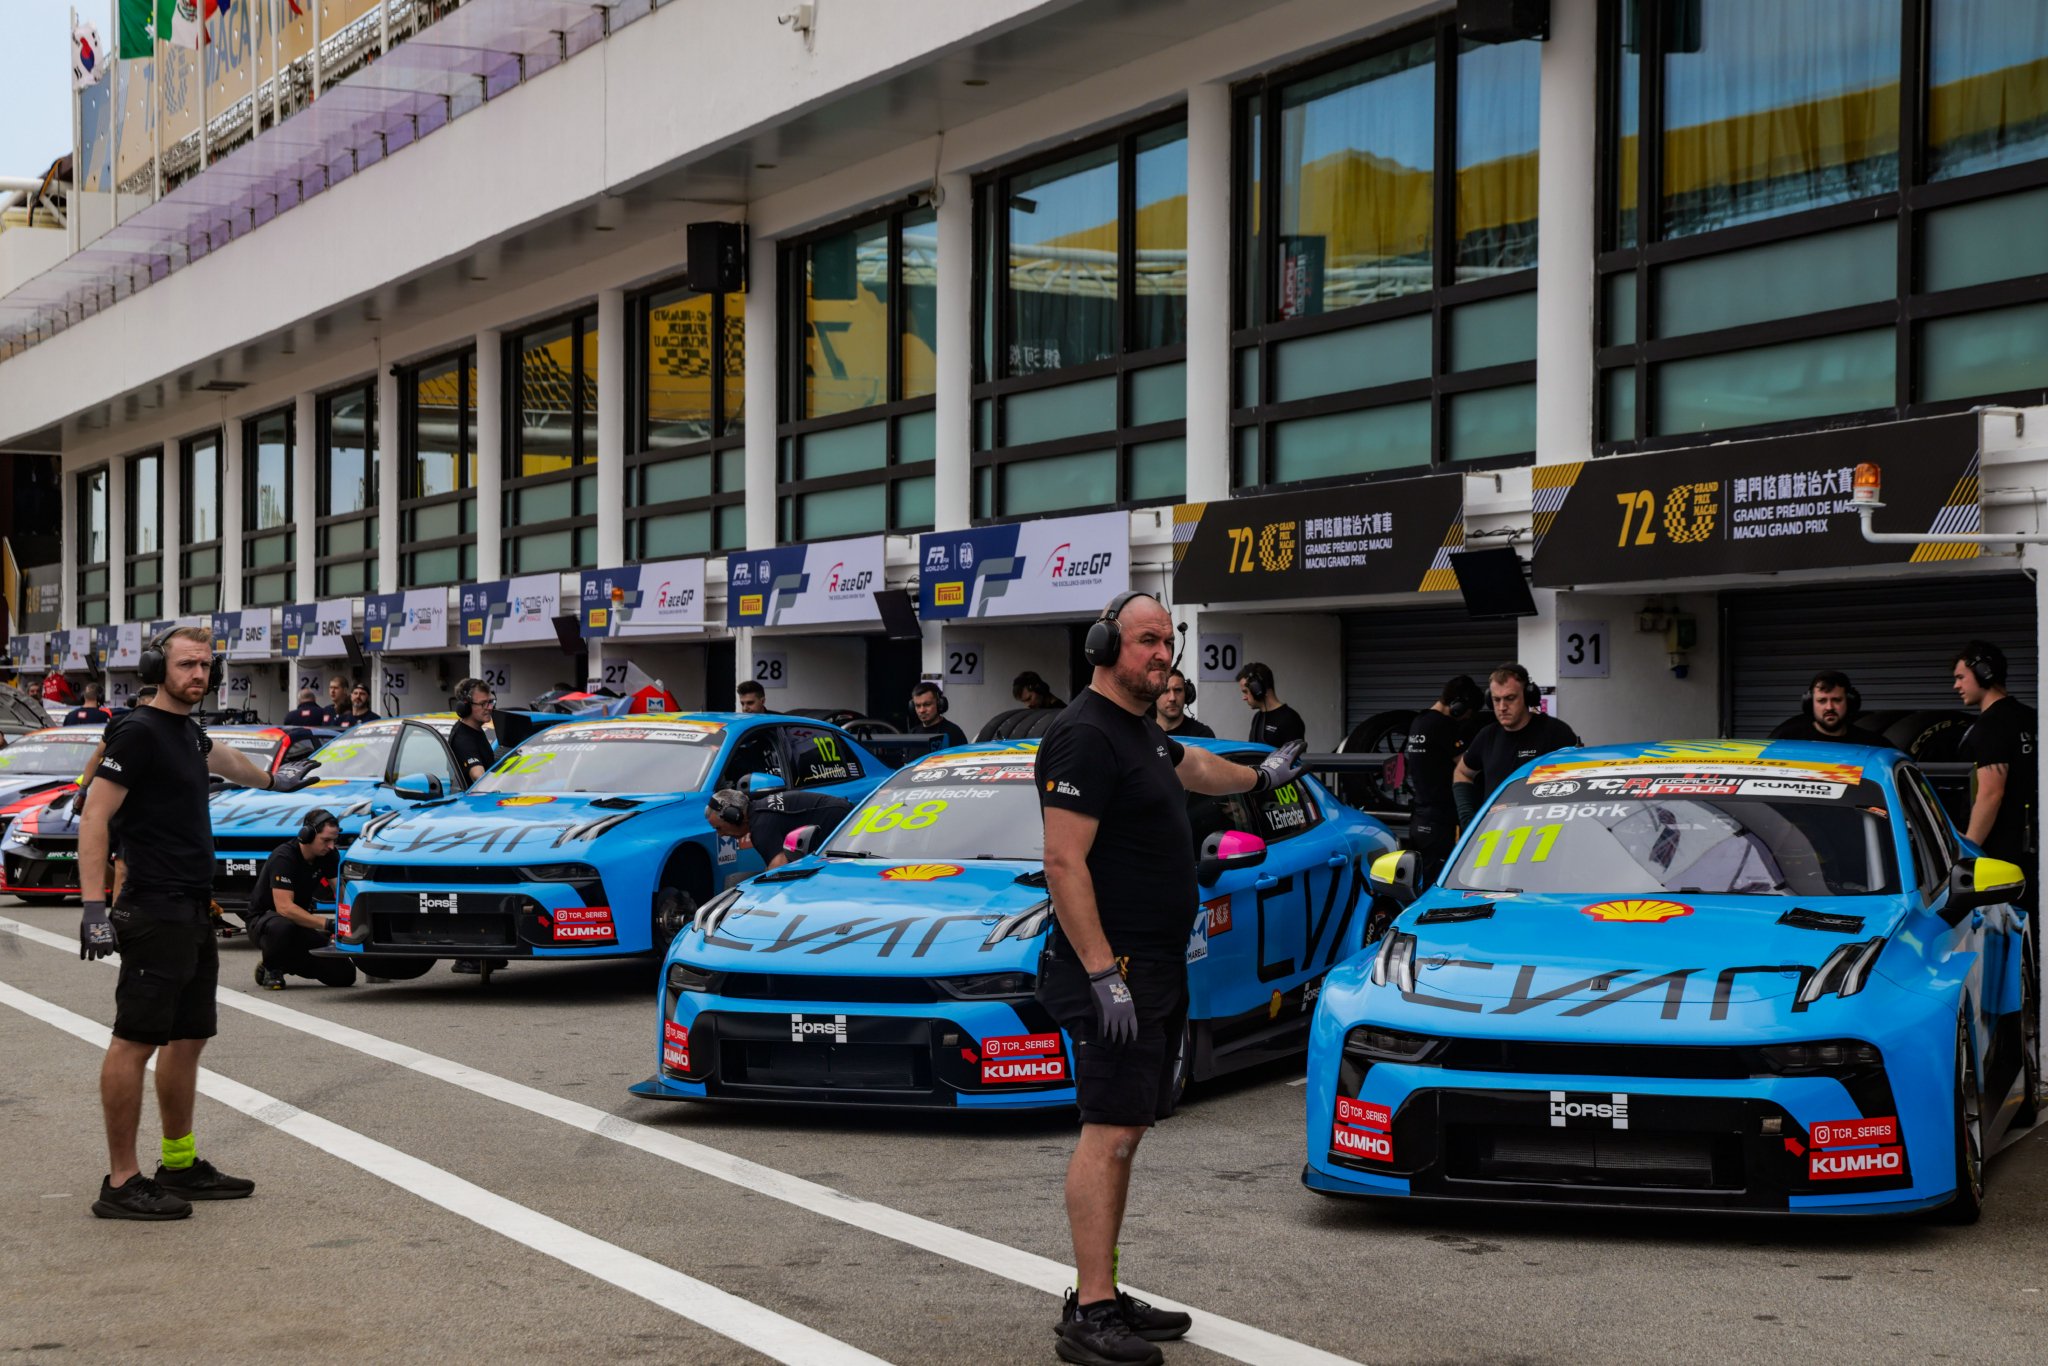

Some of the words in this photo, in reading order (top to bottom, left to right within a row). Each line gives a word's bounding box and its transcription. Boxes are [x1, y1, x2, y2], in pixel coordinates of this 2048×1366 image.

[1694, 481, 1719, 493] GRAND
[1694, 494, 1711, 504] PRIX
[1616, 489, 1656, 548] 72
[1694, 504, 1718, 517] MACAU
[1733, 504, 1775, 523] GRANDE
[1776, 501, 1814, 520] PRÉMIO
[1816, 502, 1831, 516] DE
[1733, 523, 1767, 540] MACAU
[1768, 520, 1803, 536] GRAND
[1804, 519, 1828, 534] PRIX
[1227, 526, 1255, 574] 72
[1305, 543, 1332, 555] GRANDE
[1332, 540, 1358, 554] PRÉMIO
[1358, 541, 1368, 551] DE
[1369, 538, 1393, 550] MACAU
[1305, 557, 1327, 569] MACAU
[1327, 555, 1350, 567] GRAND
[1350, 554, 1367, 566] PRIX
[937, 586, 961, 602] PIRELLI
[1567, 632, 1601, 666] 31
[949, 651, 978, 675] 29
[1204, 644, 1237, 671] 30
[485, 670, 506, 686] 26
[605, 665, 629, 684] 27
[756, 660, 782, 680] 28
[114, 683, 129, 695] 21
[231, 678, 249, 691] 23
[301, 677, 319, 690] 24
[387, 673, 404, 689] 25
[813, 736, 841, 762] 112
[1057, 785, 1081, 797] HELIX
[1539, 783, 1573, 796] FIA
[1587, 777, 1653, 790] TCR
[1665, 785, 1730, 794] TOUR
[1752, 782, 1832, 791] KUMHO
[848, 799, 948, 837] 168
[1523, 803, 1629, 822] T.Björk
[1473, 824, 1563, 869] 111
[226, 861, 257, 874] HORSE
[420, 895, 458, 911] HORSE
[568, 911, 608, 920] TCR_SERIES
[556, 926, 612, 937] KUMHO
[791, 1017, 847, 1039] HORSE
[1001, 1040, 1055, 1051] TCR_SERIES
[984, 1061, 1062, 1078] KUMHO
[1349, 1106, 1388, 1124] TCR_SERIES
[1550, 1096, 1628, 1124] HORSE
[1832, 1125, 1891, 1140] TCR_SERIES
[1335, 1130, 1390, 1156] KUMHO
[1812, 1152, 1899, 1174] KUMHO
